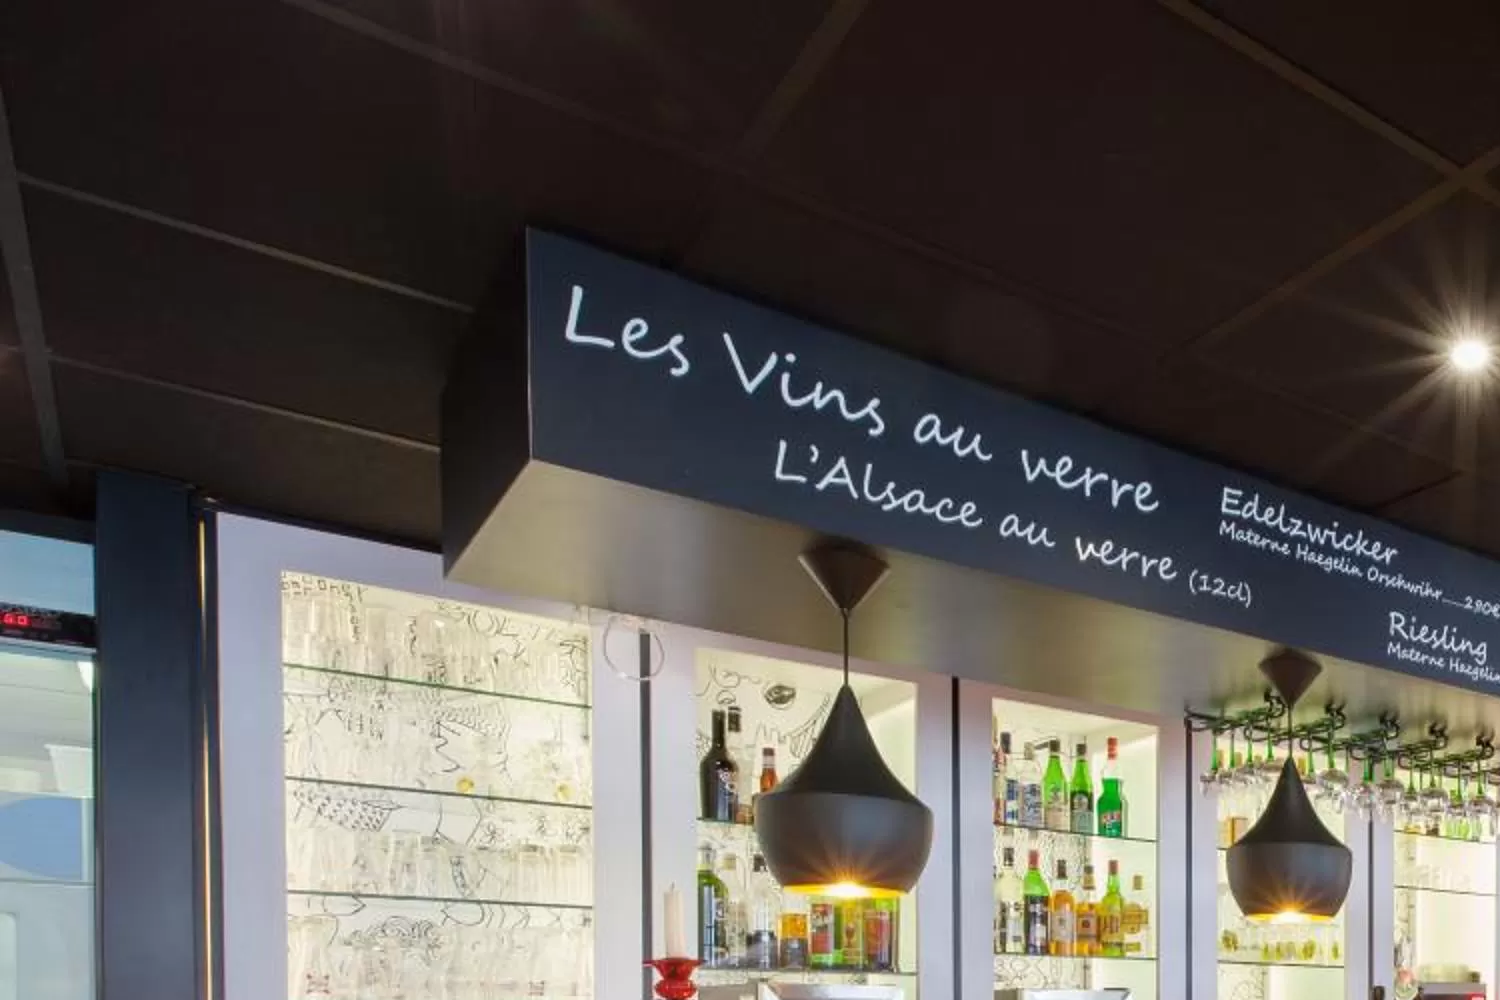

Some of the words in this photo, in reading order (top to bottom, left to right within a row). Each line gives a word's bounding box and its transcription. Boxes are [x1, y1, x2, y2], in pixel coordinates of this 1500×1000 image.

[564, 284, 690, 378] Les
[723, 331, 886, 437] Vins
[913, 412, 993, 463] au
[1020, 448, 1160, 513] verre
[775, 440, 984, 528] L'Alsace
[1000, 512, 1056, 549] au
[1075, 534, 1178, 582] verre
[1189, 568, 1252, 609] (12cl)
[1219, 519, 1292, 556] Materne
[1221, 486, 1400, 566] Edelzwicker
[1388, 610, 1488, 666] Riesling
